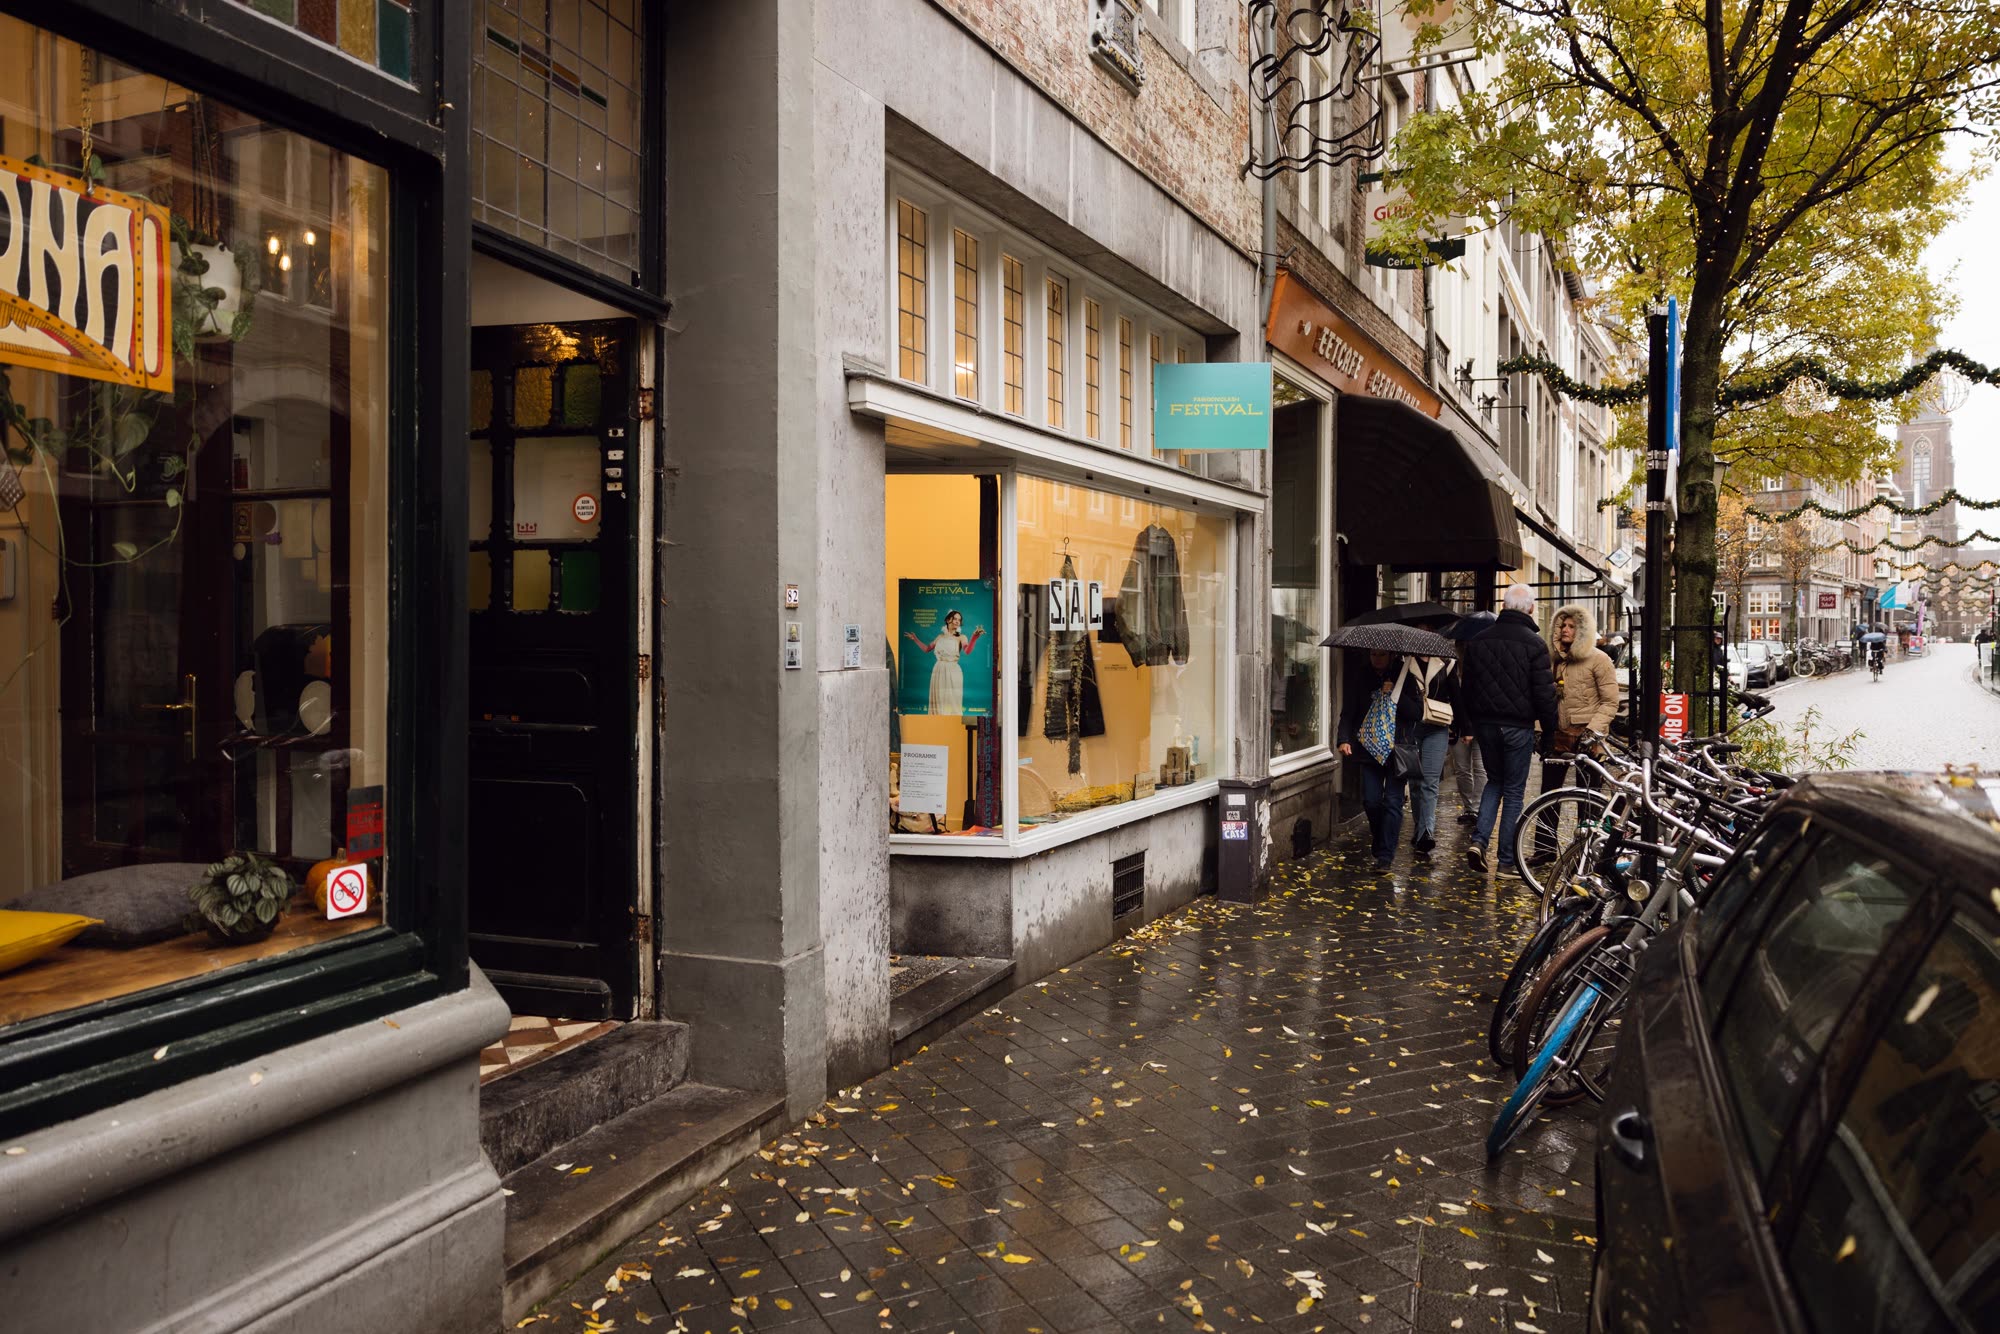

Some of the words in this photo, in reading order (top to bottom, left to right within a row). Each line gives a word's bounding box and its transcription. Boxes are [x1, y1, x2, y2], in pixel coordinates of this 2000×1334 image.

[1169, 403, 1264, 416] FESTIVAL
[787, 589, 798, 602] 82
[918, 586, 975, 595] FESTIVAL
[1664, 695, 1683, 715] NO
[1664, 718, 1683, 744] BIK
[1224, 830, 1245, 839] CATS
